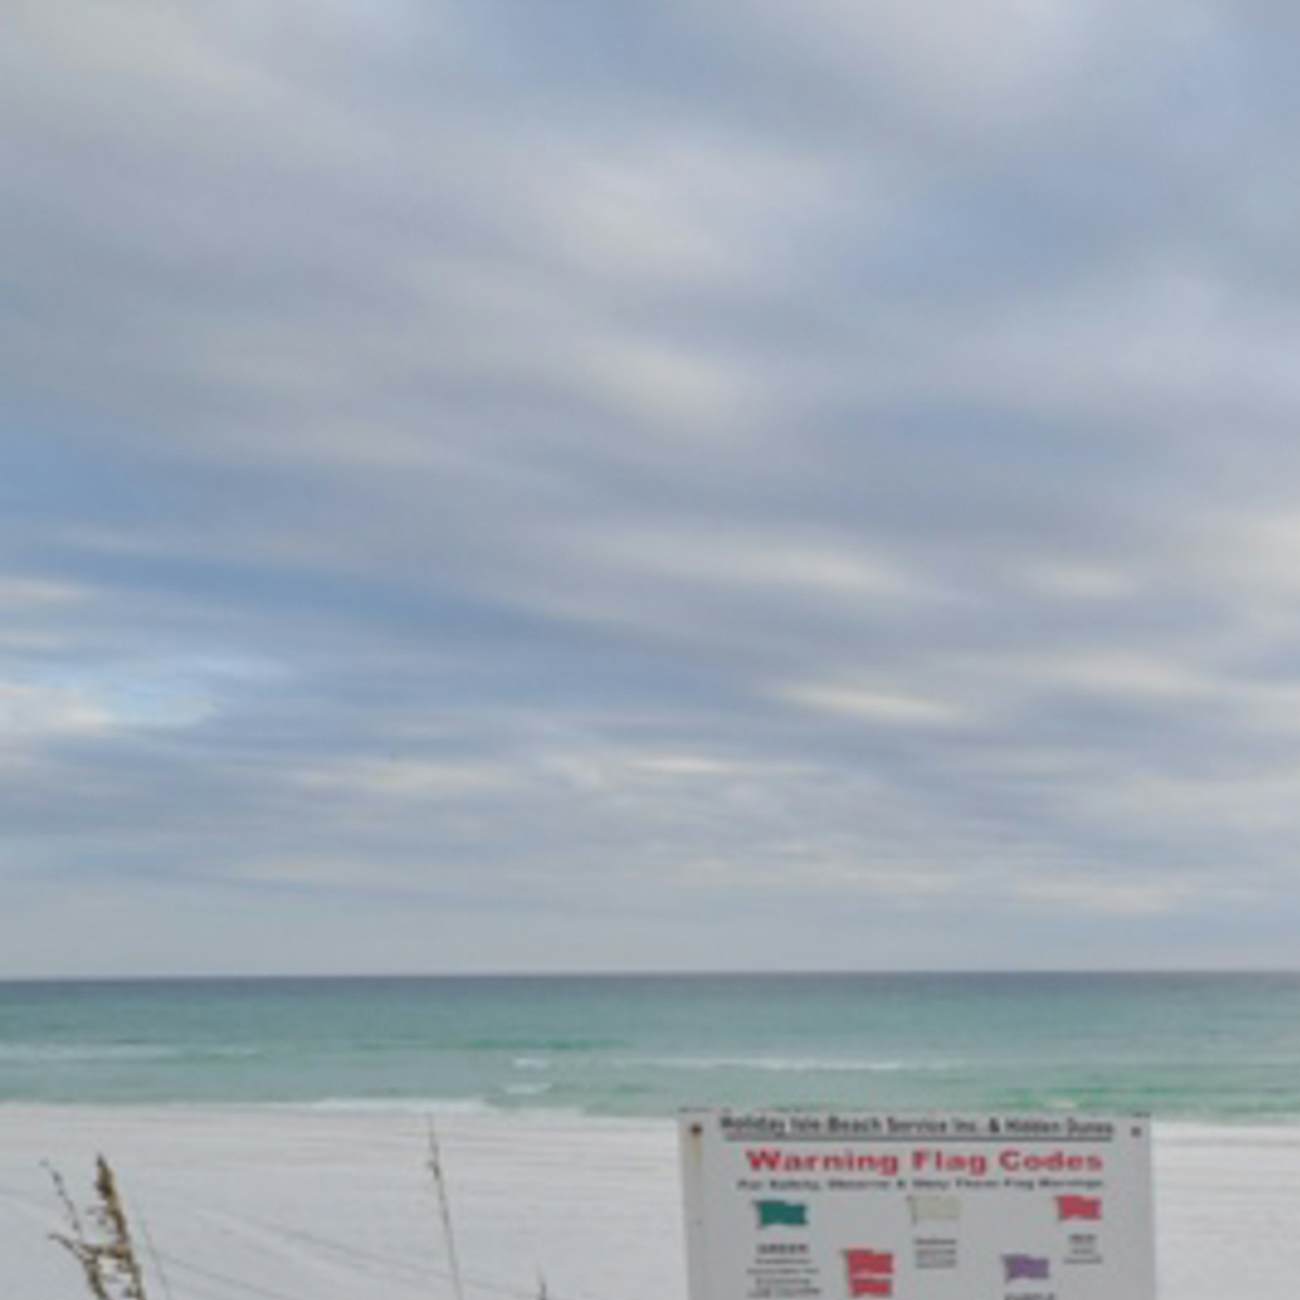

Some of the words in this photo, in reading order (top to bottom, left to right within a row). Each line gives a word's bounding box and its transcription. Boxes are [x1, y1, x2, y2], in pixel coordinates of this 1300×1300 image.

[745, 1150, 899, 1176] Warning
[911, 1150, 987, 1175] Flag
[999, 1150, 1103, 1172] Codes
